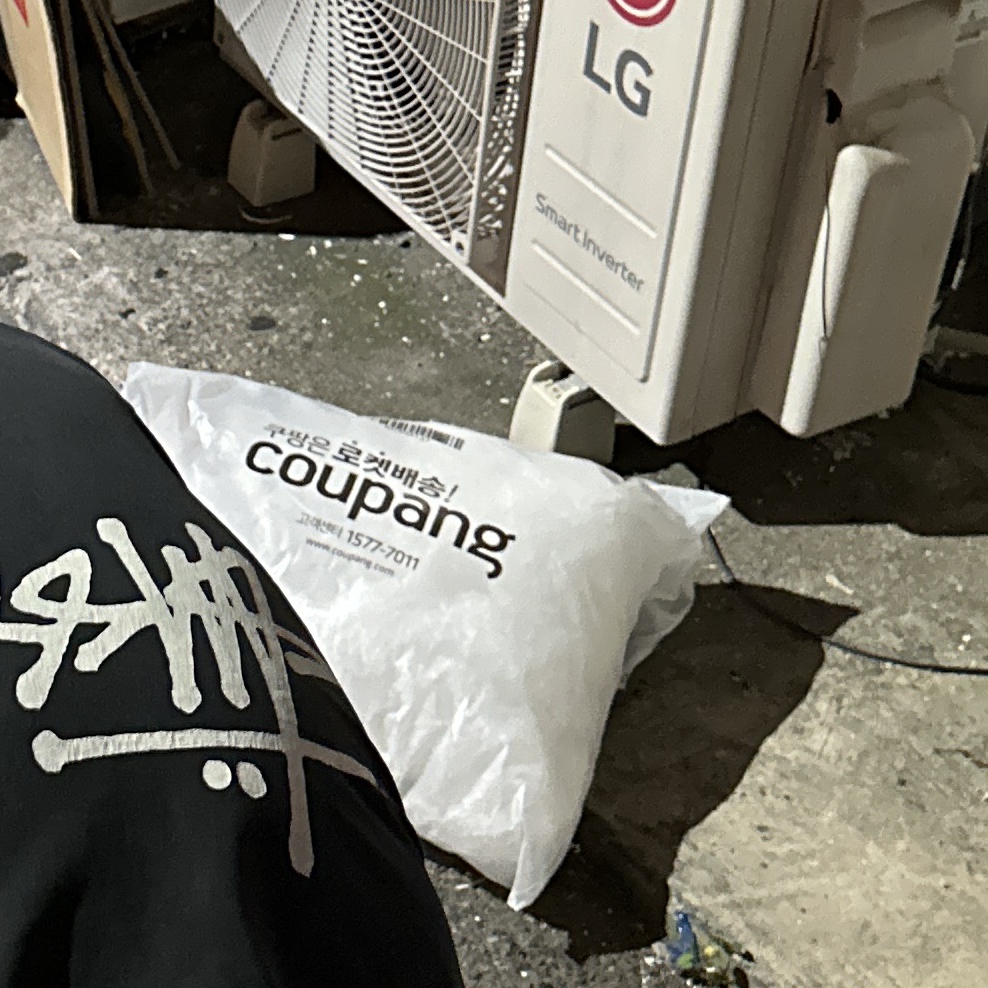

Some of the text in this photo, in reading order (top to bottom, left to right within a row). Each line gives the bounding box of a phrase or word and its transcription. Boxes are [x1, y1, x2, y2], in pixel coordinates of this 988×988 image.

[582, 20, 655, 119] LG
[535, 192, 645, 292] Smart Inverter
[245, 441, 516, 579] coupang
[332, 439, 459, 503] 로켓배송!
[305, 537, 395, 577] www.coupang.com
[346, 530, 420, 571] 1577-7011
